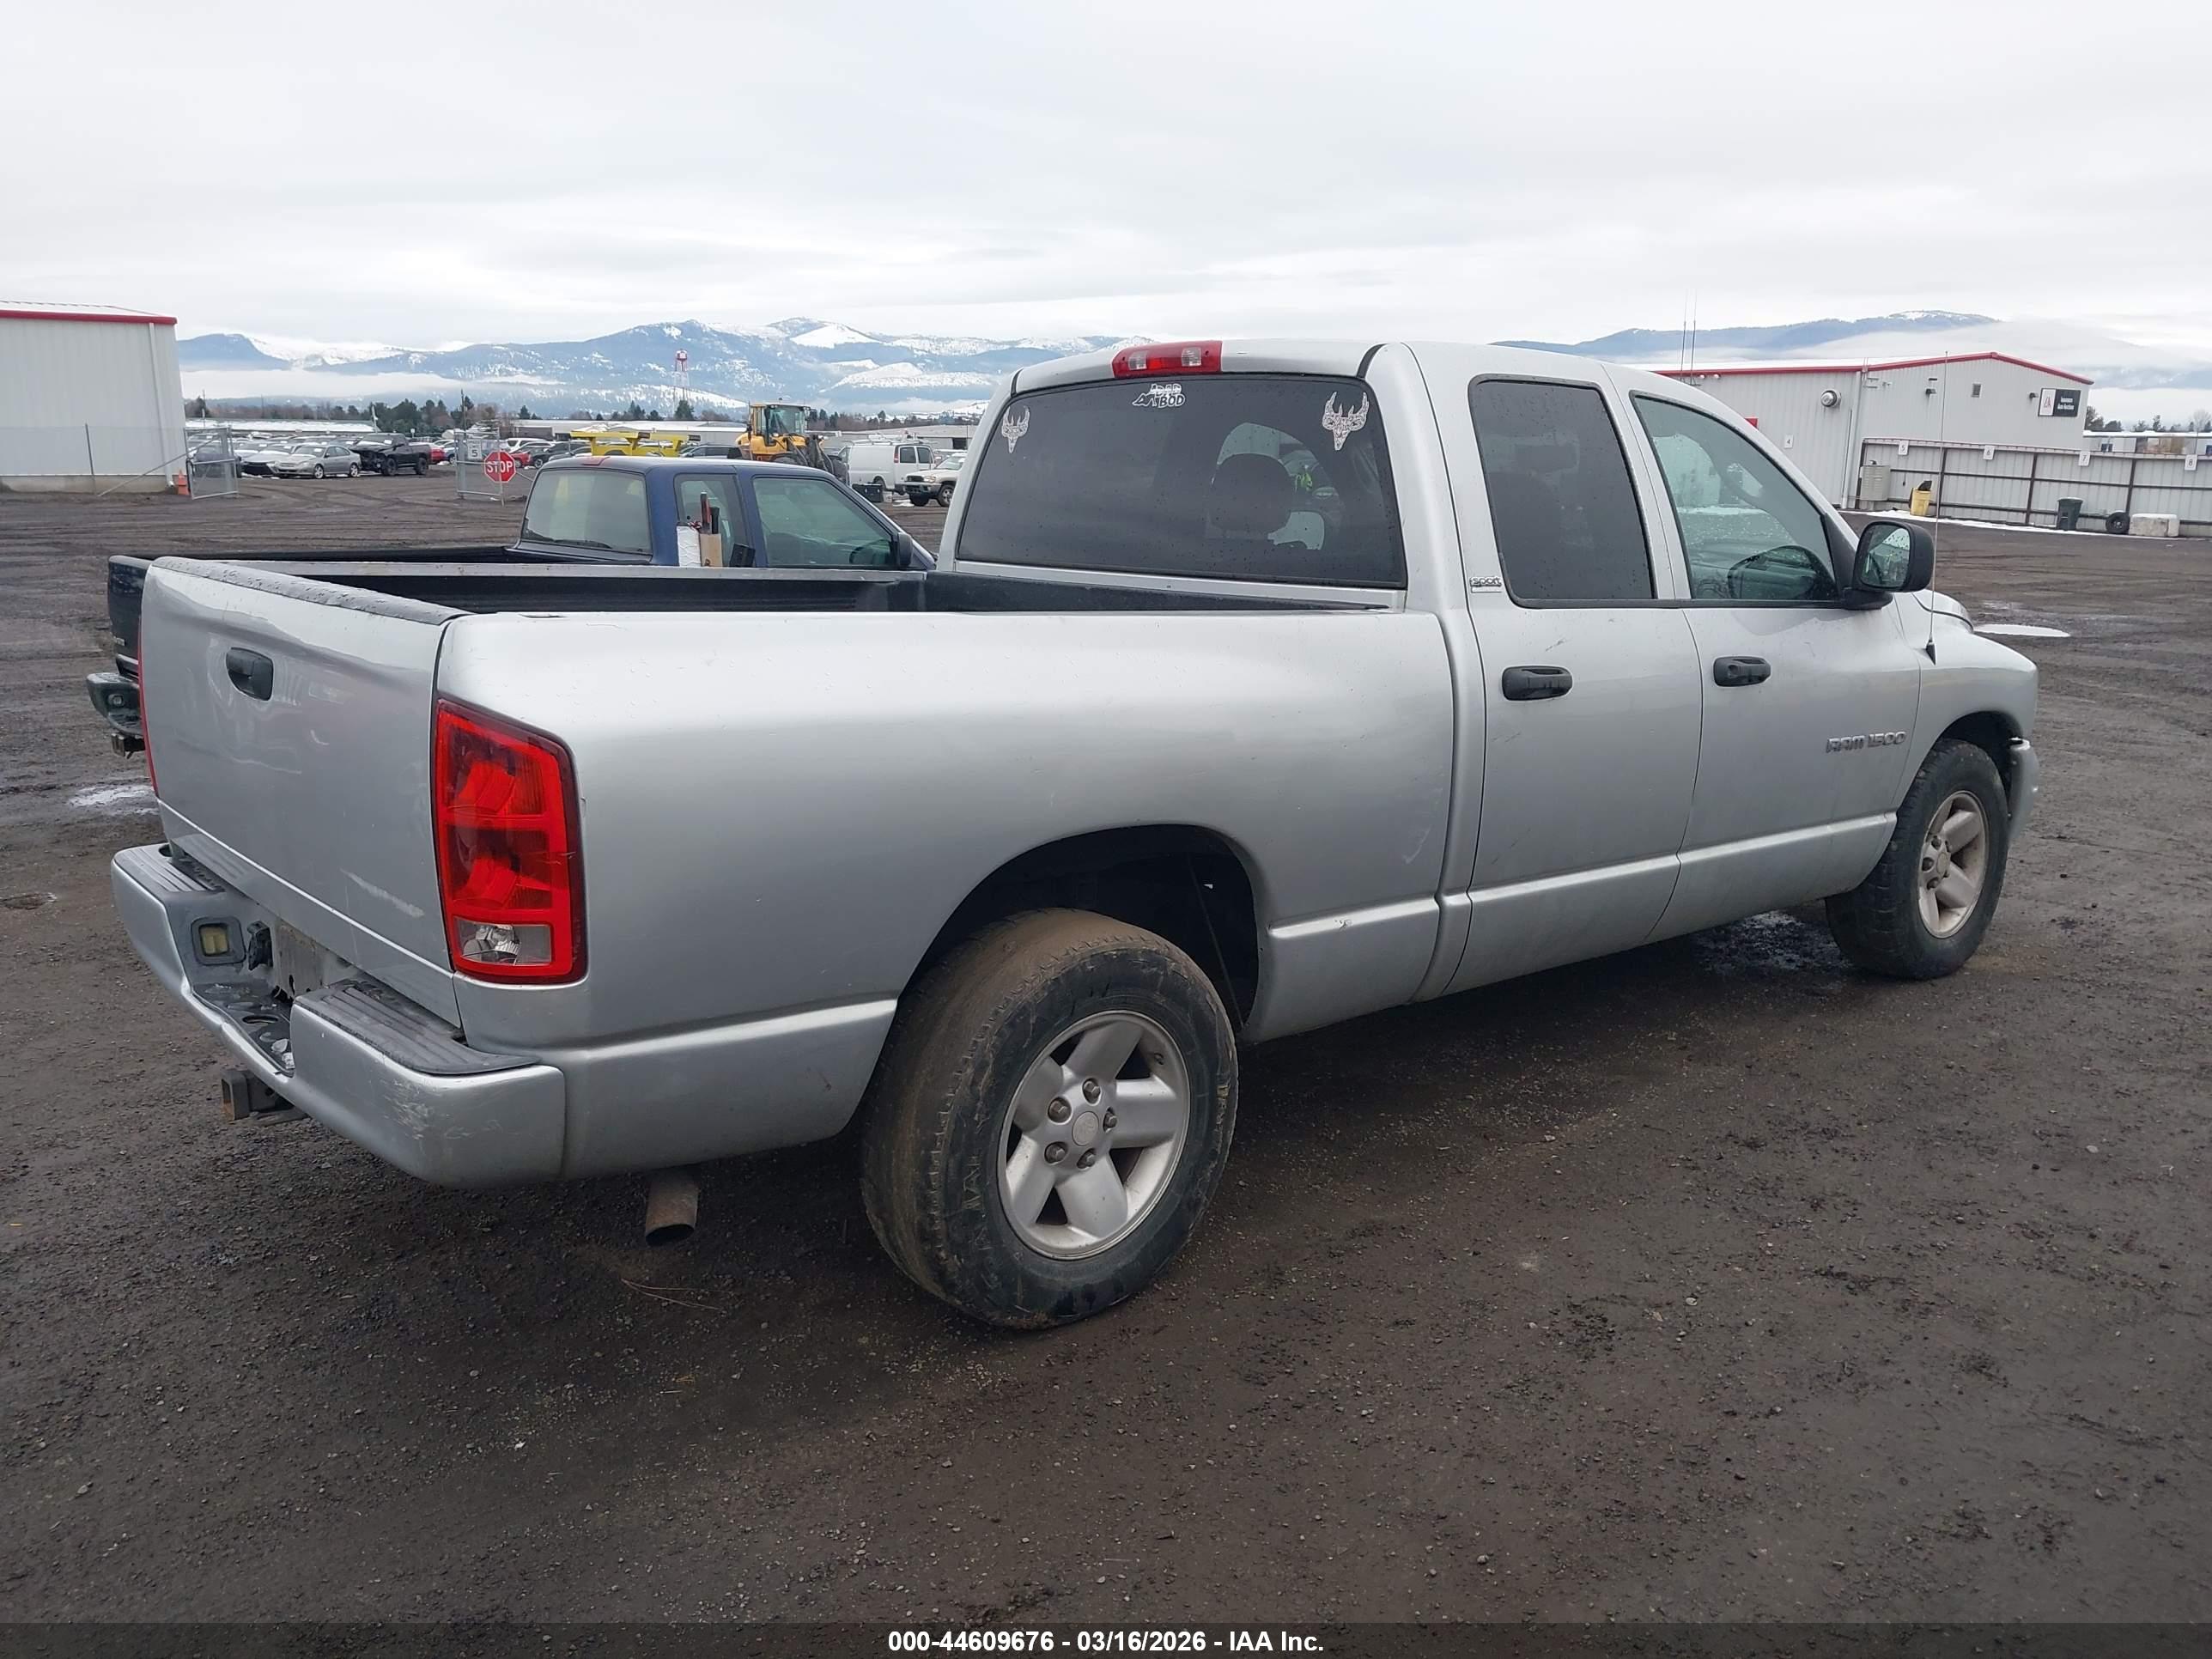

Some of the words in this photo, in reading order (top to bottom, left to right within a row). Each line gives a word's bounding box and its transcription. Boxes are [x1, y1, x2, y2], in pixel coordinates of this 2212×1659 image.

[1158, 393, 1185, 408] BOD
[471, 449, 478, 458] 5
[487, 460, 514, 473] STOP
[1826, 735, 1865, 753] RAM
[1868, 731, 1906, 748] 1500
